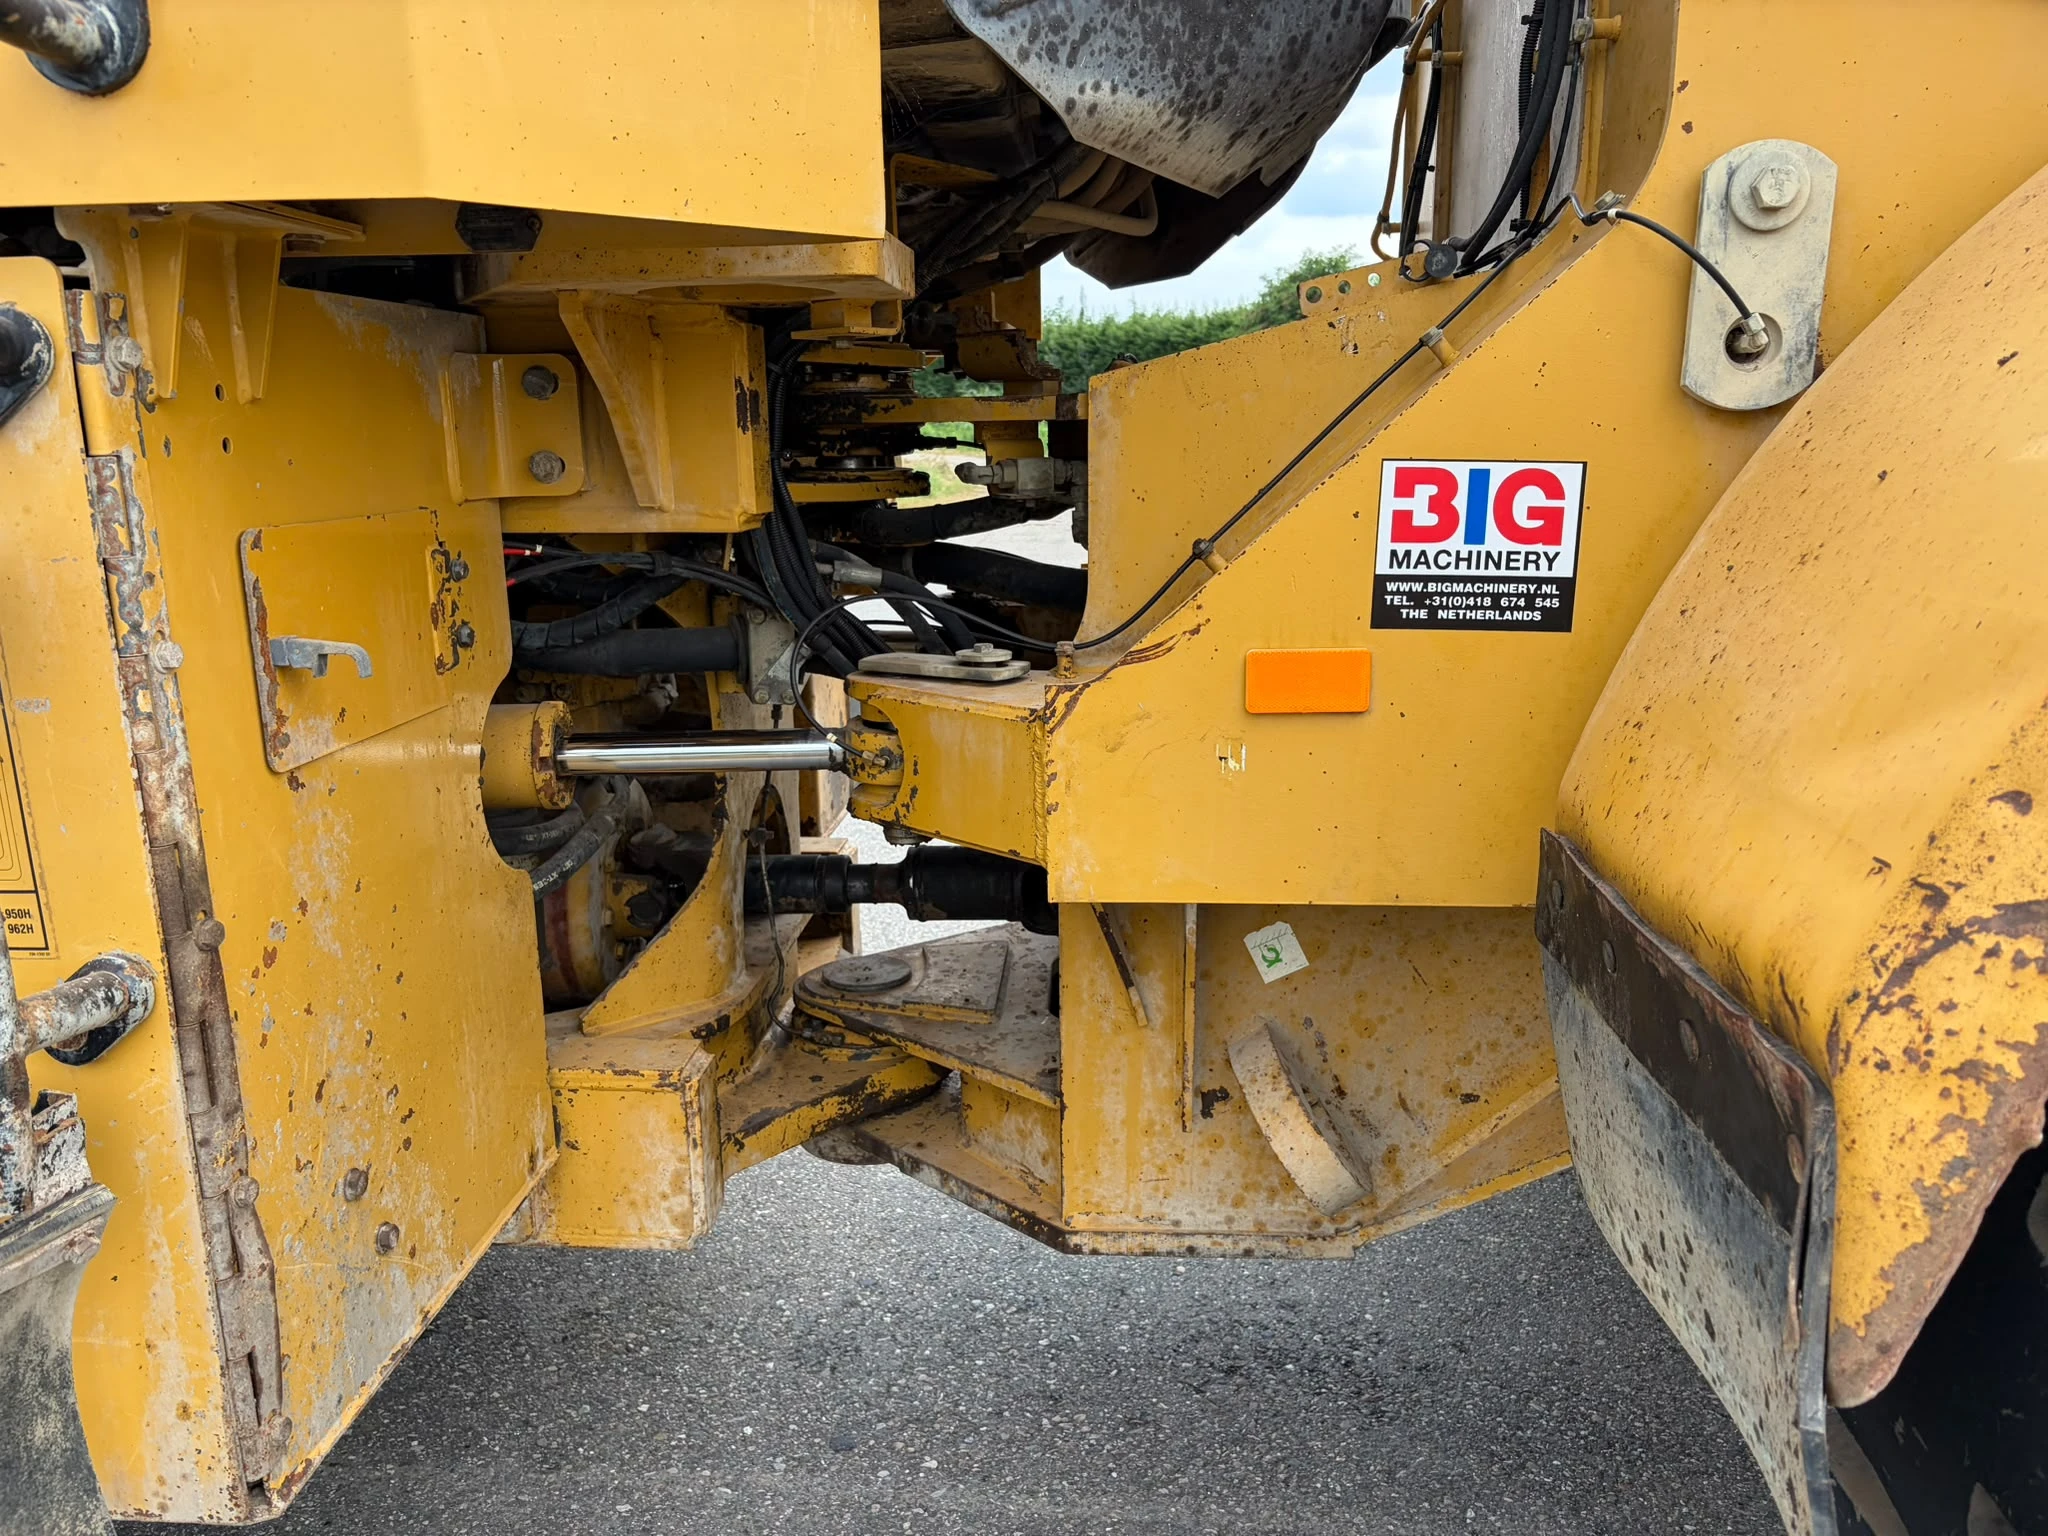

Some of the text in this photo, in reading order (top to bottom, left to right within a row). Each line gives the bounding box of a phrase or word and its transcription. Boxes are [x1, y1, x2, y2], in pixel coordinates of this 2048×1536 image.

[1390, 467, 1566, 546] BIG
[1388, 549, 1561, 572] MACHINERY
[1386, 581, 1560, 595] WWW.BIGMACHINERY.NL
[1384, 595, 1560, 608] TEL. +31(0)418 674 545
[1400, 608, 1542, 621] THE NETHERLANDS
[5, 908, 31, 919] 950H
[7, 923, 34, 934] 962H
